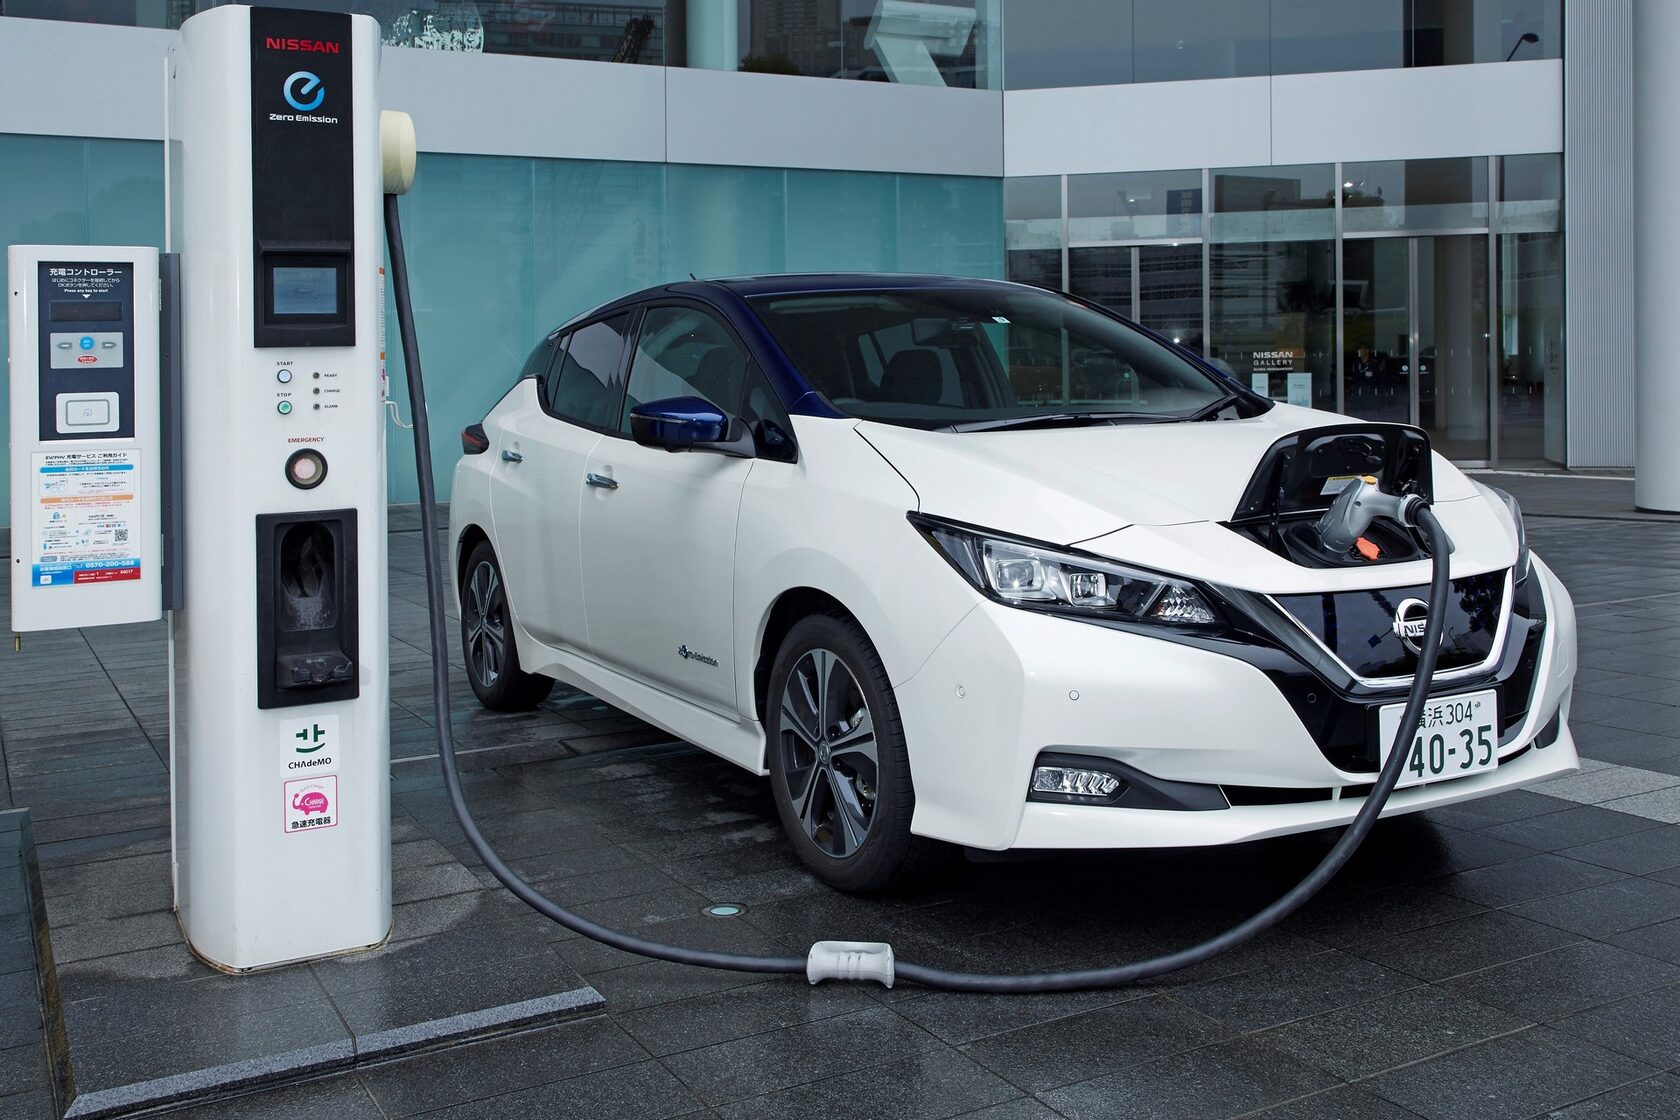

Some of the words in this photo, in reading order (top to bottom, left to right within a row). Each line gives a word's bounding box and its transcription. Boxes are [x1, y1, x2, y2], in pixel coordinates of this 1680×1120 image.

[266, 38, 340, 54] NISSAN
[269, 113, 294, 121] Zero
[296, 114, 338, 124] Emission
[49, 268, 122, 276] 充電コントローラー
[1253, 351, 1293, 359] NISSAN
[1404, 622, 1425, 634] NIS
[1446, 701, 1472, 725] 304
[1409, 725, 1492, 778] 40-35
[291, 816, 331, 829] 急速充電器
